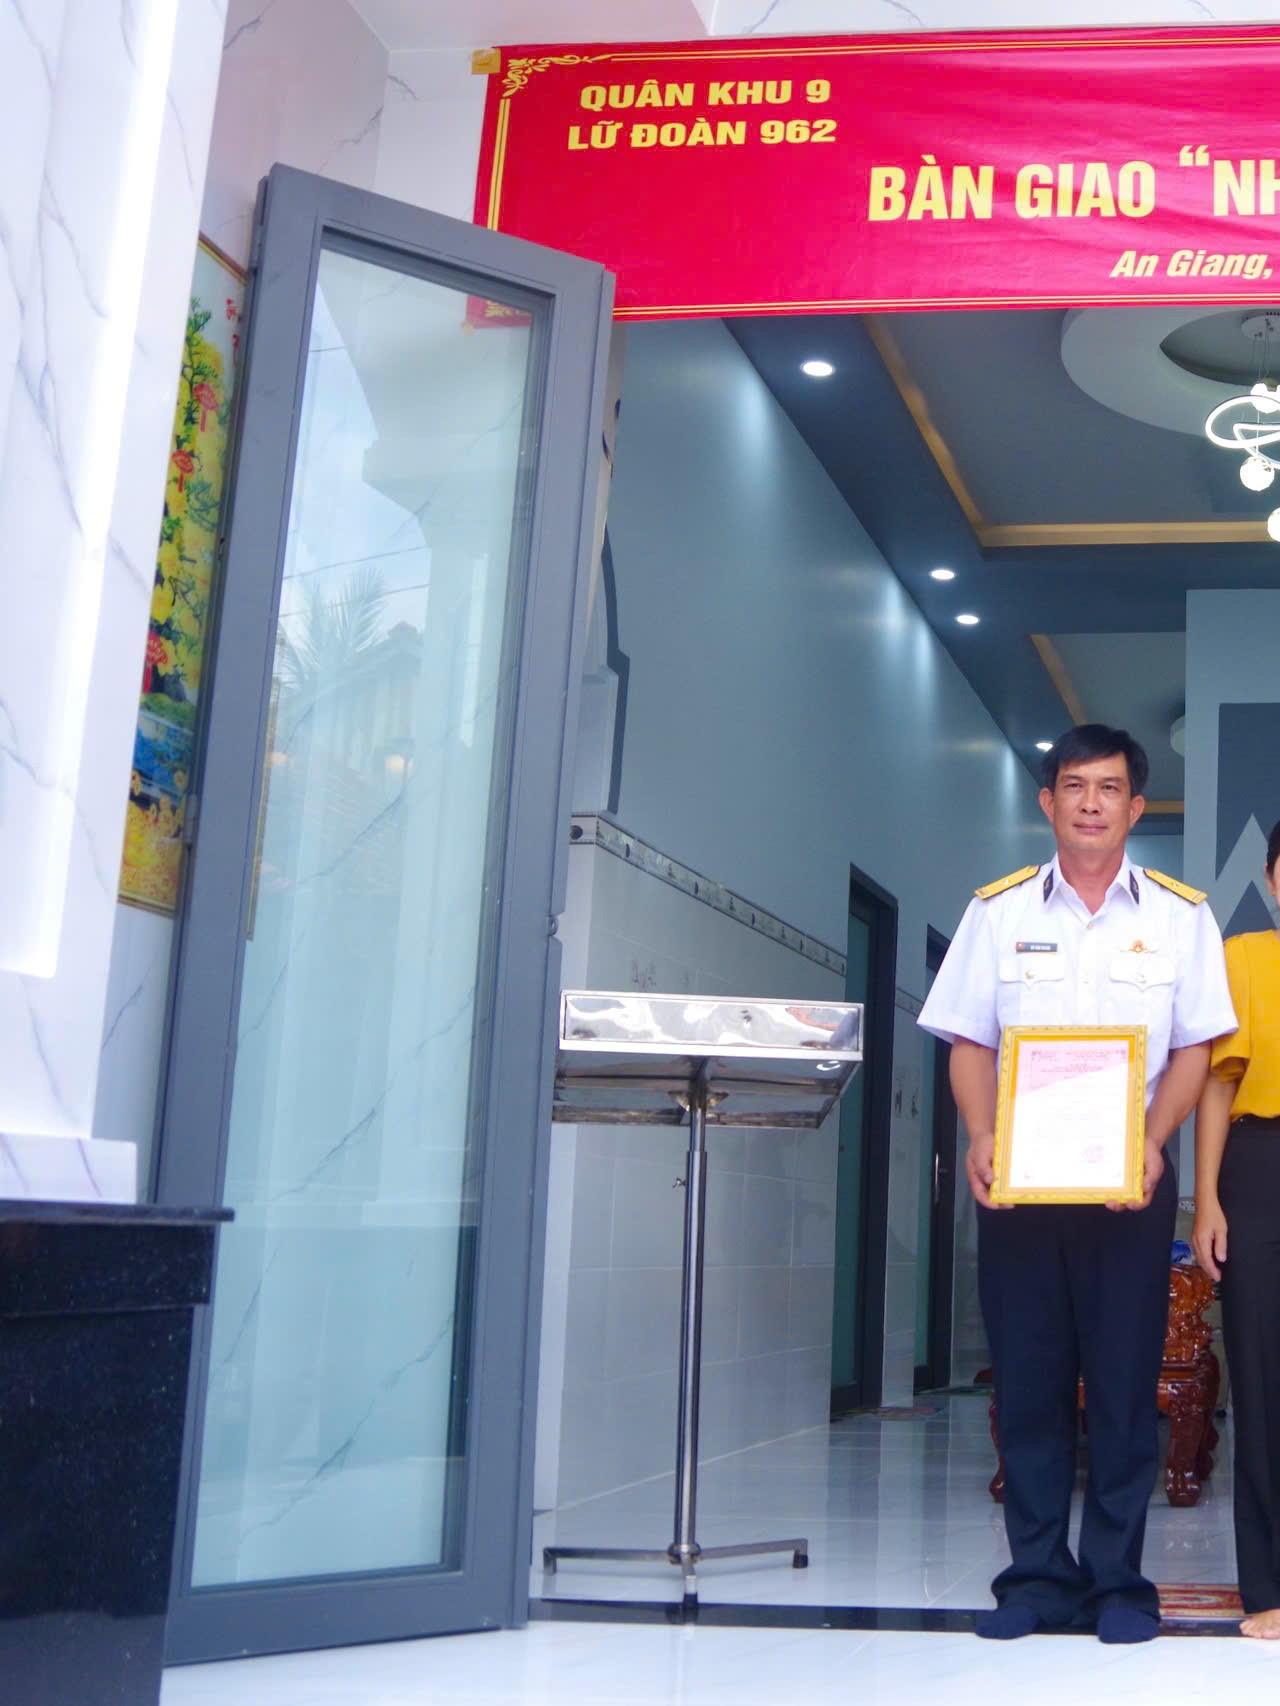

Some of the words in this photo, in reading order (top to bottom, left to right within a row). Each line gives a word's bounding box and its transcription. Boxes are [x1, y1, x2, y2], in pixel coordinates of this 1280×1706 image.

[581, 78, 695, 112] QUÂN
[708, 80, 792, 106] KHU
[806, 79, 831, 104] 9
[568, 119, 624, 150] LỮ
[630, 116, 746, 147] ĐOÀN
[760, 119, 837, 146] 962
[868, 155, 995, 222] BÀN
[1014, 161, 1156, 220] GIAO
[1108, 250, 1159, 279] An
[1165, 249, 1274, 281] Giang,
